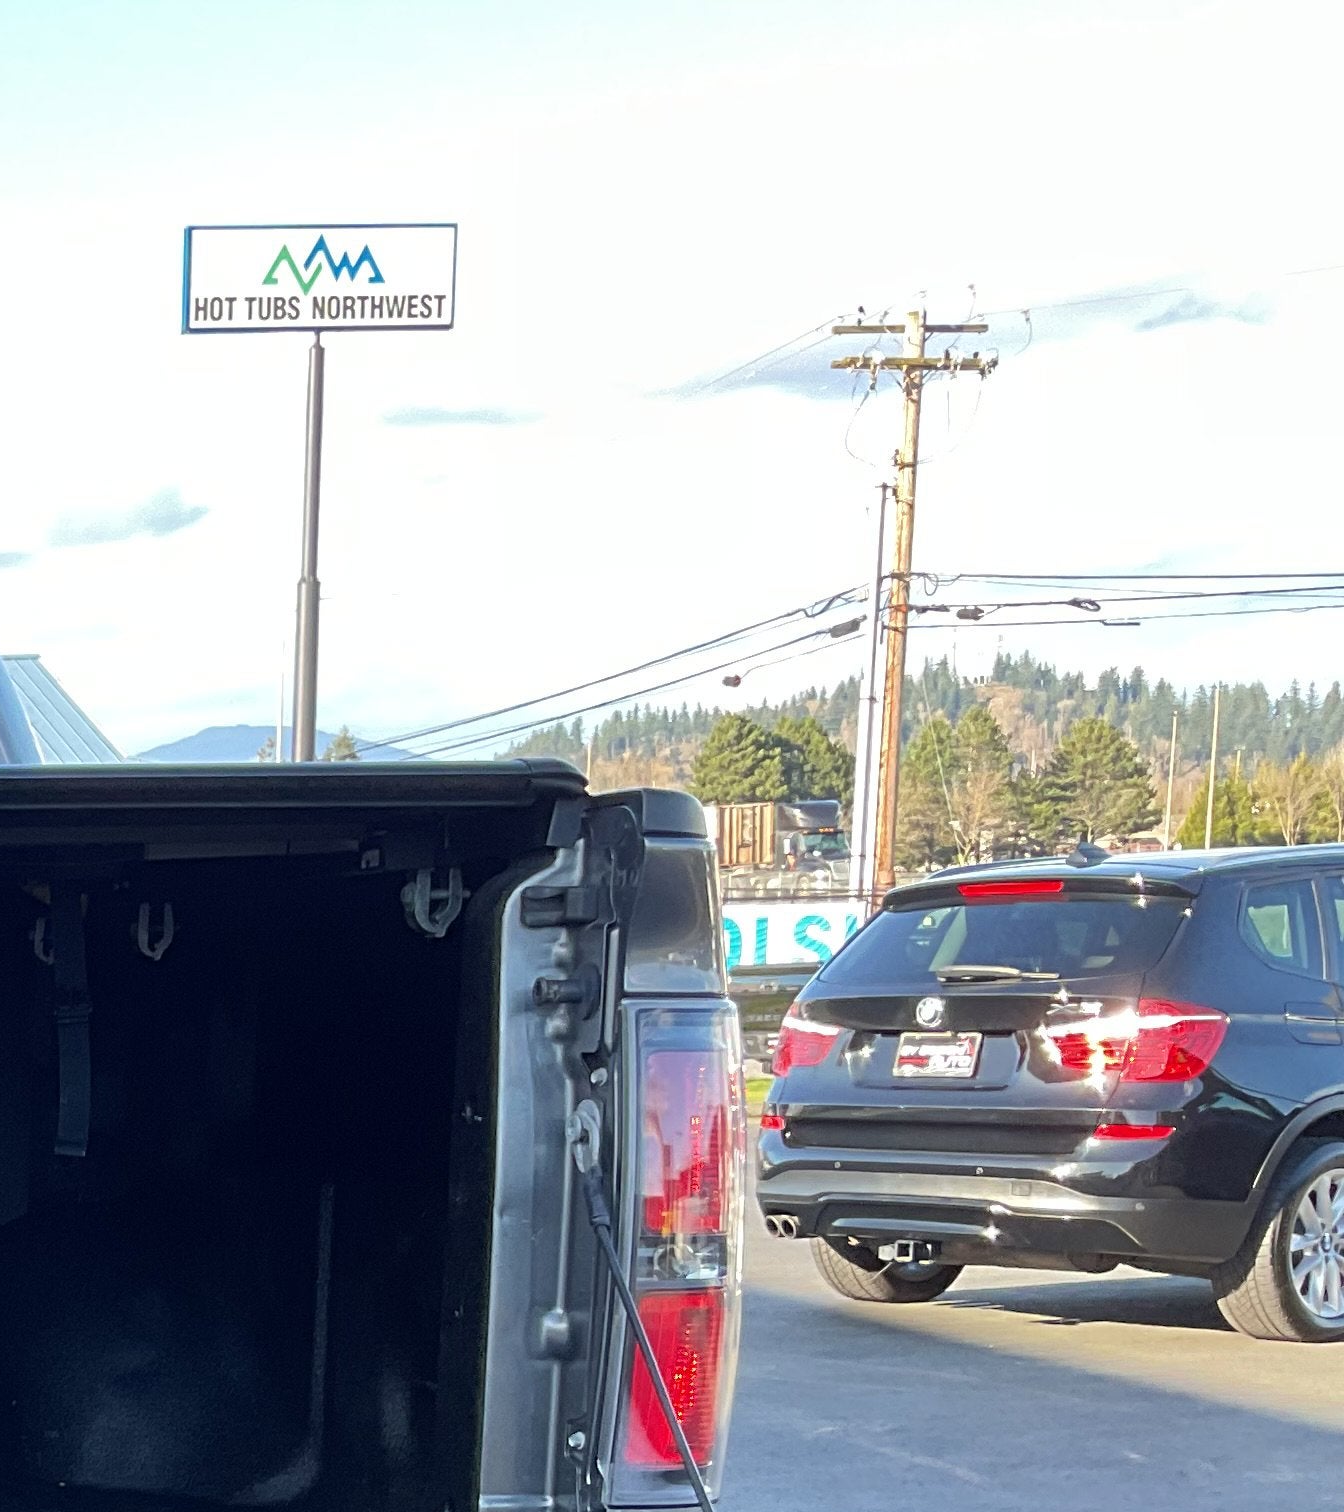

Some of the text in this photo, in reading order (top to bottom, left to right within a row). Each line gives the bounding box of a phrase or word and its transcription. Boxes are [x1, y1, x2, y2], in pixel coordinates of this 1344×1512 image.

[194, 294, 447, 321] HOT TUBS NORTHWEST
